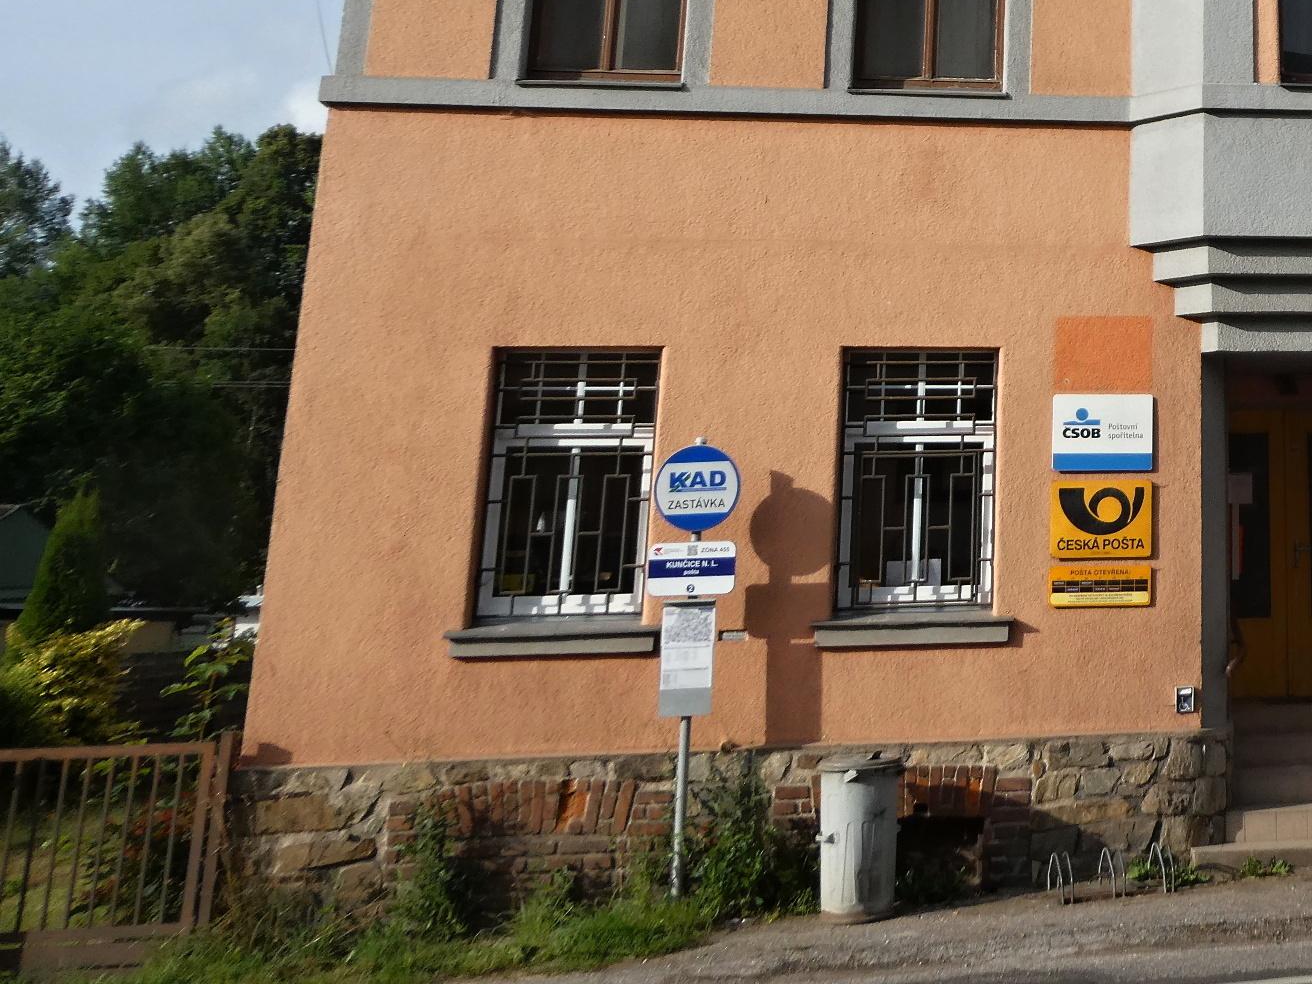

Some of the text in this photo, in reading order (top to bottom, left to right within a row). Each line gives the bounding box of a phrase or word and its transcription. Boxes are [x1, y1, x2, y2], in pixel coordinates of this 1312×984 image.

[1062, 426, 1101, 439] ČSOB
[1108, 431, 1144, 440] spořitelna
[669, 470, 727, 490] KAD
[668, 496, 726, 510] ZASTÁVKA
[1057, 536, 1145, 551] ČESKÁ POŠTA
[665, 559, 701, 569] KUNČICE
[702, 559, 710, 568] N.
